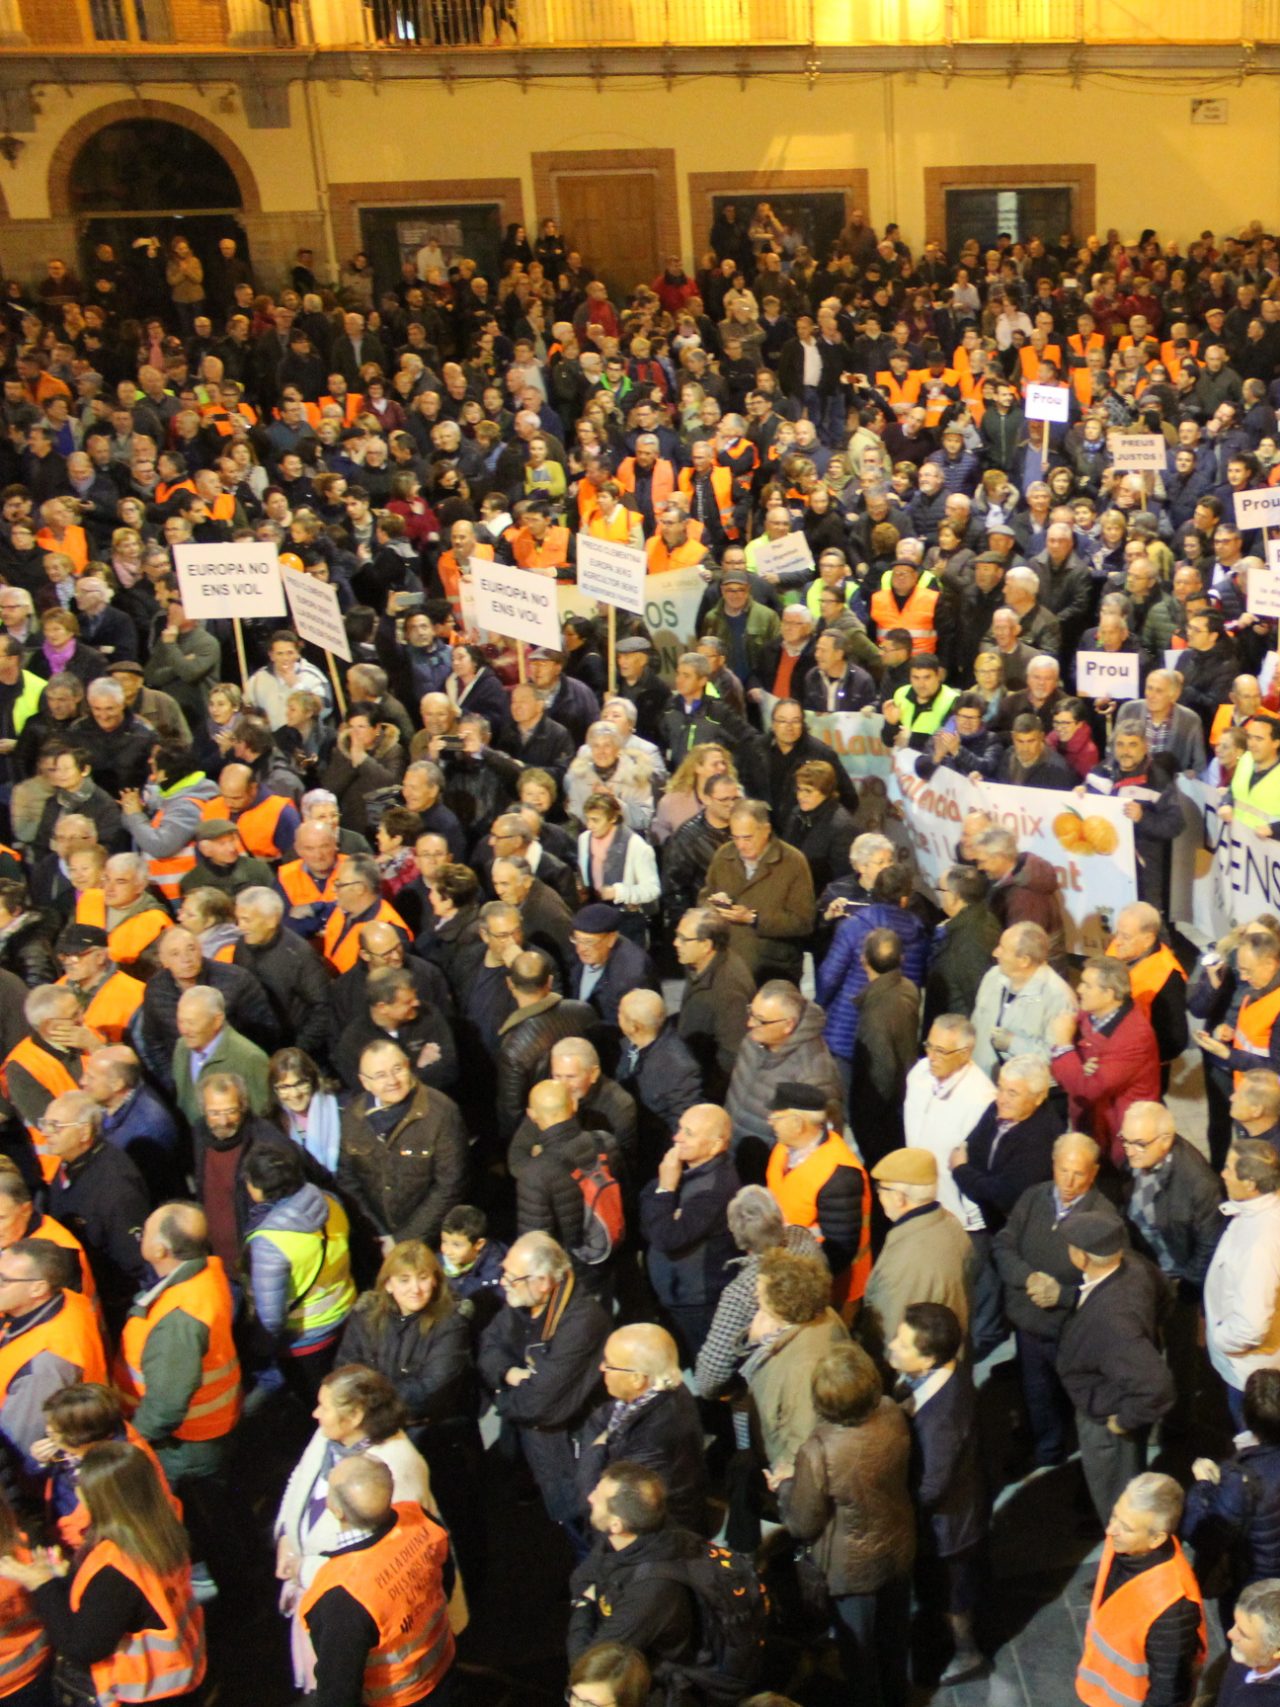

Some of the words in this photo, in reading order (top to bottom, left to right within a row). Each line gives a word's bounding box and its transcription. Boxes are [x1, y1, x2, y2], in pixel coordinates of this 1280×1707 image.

[1032, 392, 1062, 405] Prou
[1121, 439, 1155, 448] PREUS
[1117, 453, 1156, 461] JUSTOS
[1242, 498, 1280, 511] Prou
[188, 562, 245, 577] EUROPA
[249, 562, 269, 575] NO
[202, 583, 230, 596] ENS
[234, 583, 262, 596] VOL
[480, 578, 528, 601] EUROPA
[531, 592, 548, 607] NO
[491, 600, 515, 618] ENS
[519, 608, 541, 625] VOL
[1086, 660, 1129, 677] Prou
